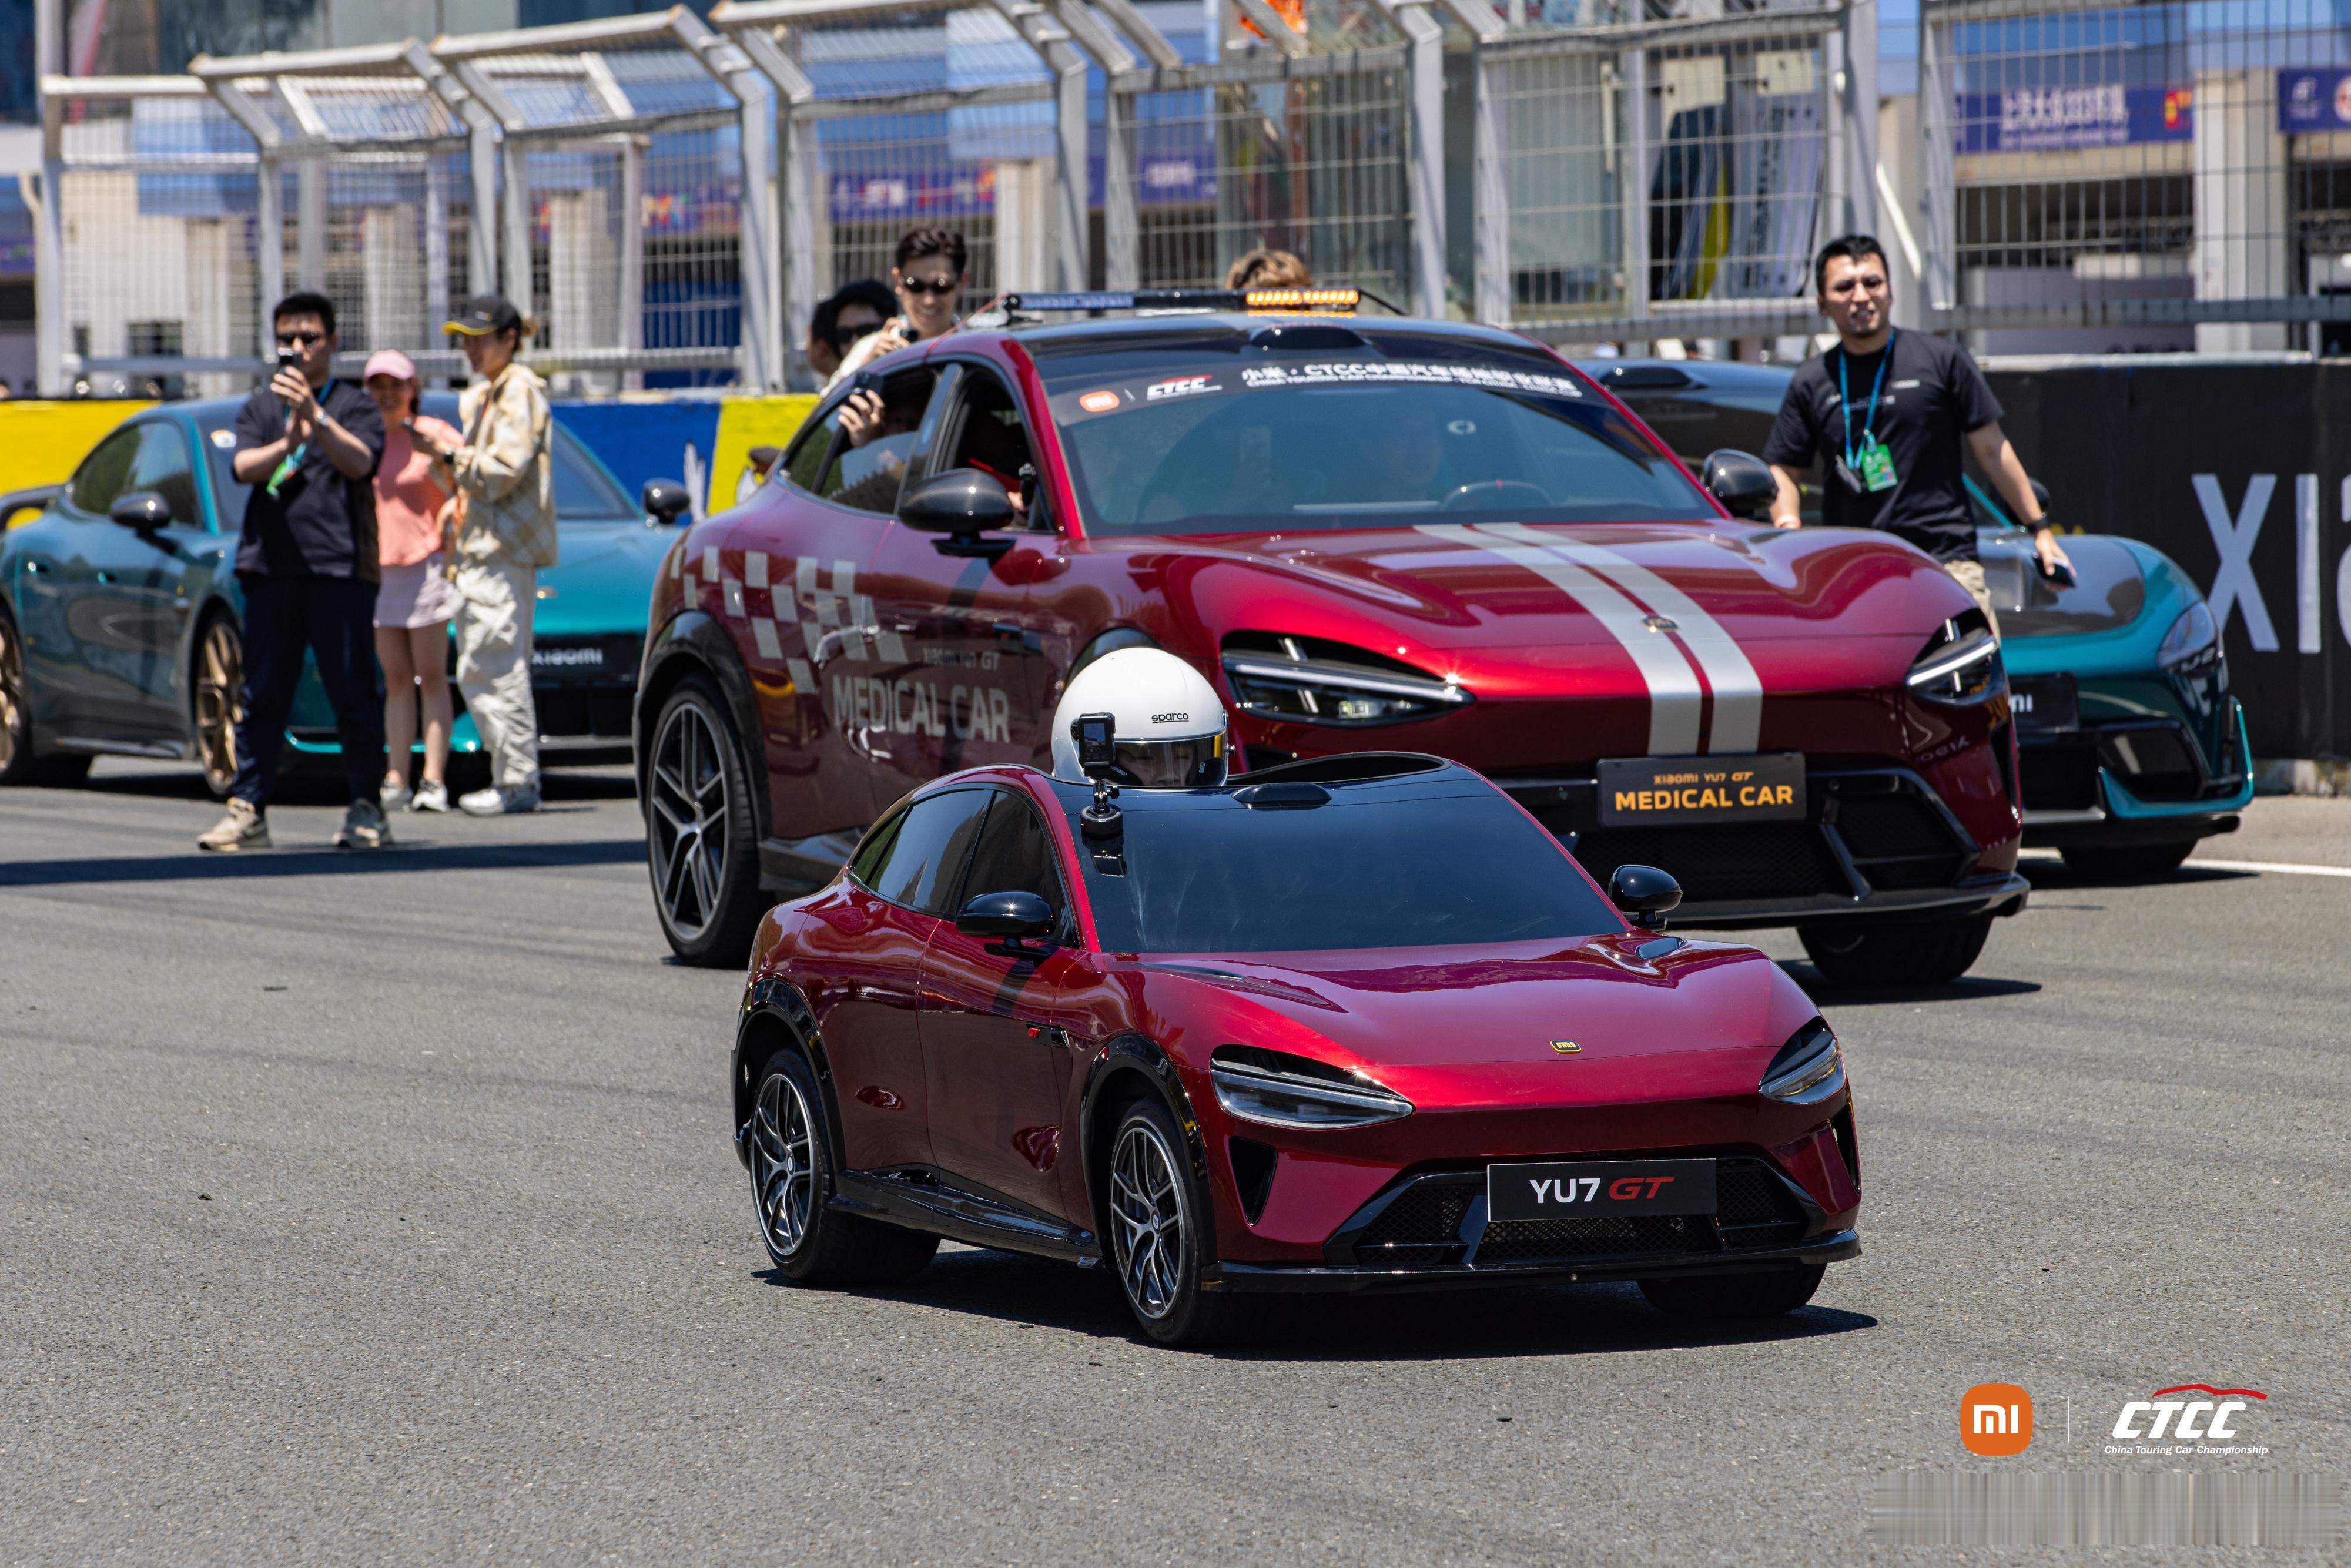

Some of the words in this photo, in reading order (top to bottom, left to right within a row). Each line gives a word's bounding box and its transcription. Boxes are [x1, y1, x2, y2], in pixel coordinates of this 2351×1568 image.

[2191, 473, 2351, 654] XI
[832, 674, 946, 738] MEDICAL
[950, 684, 1010, 743] CAR
[1151, 712, 1190, 724] sparco
[1703, 772, 1726, 783] YU7
[1732, 771, 1754, 782] GT
[1615, 788, 1733, 811] MEDICAL
[1739, 785, 1793, 807] CAR
[1029, 1027, 1042, 1038] GT
[1529, 1178, 1600, 1204] YU7
[1609, 1177, 1675, 1200] GT
